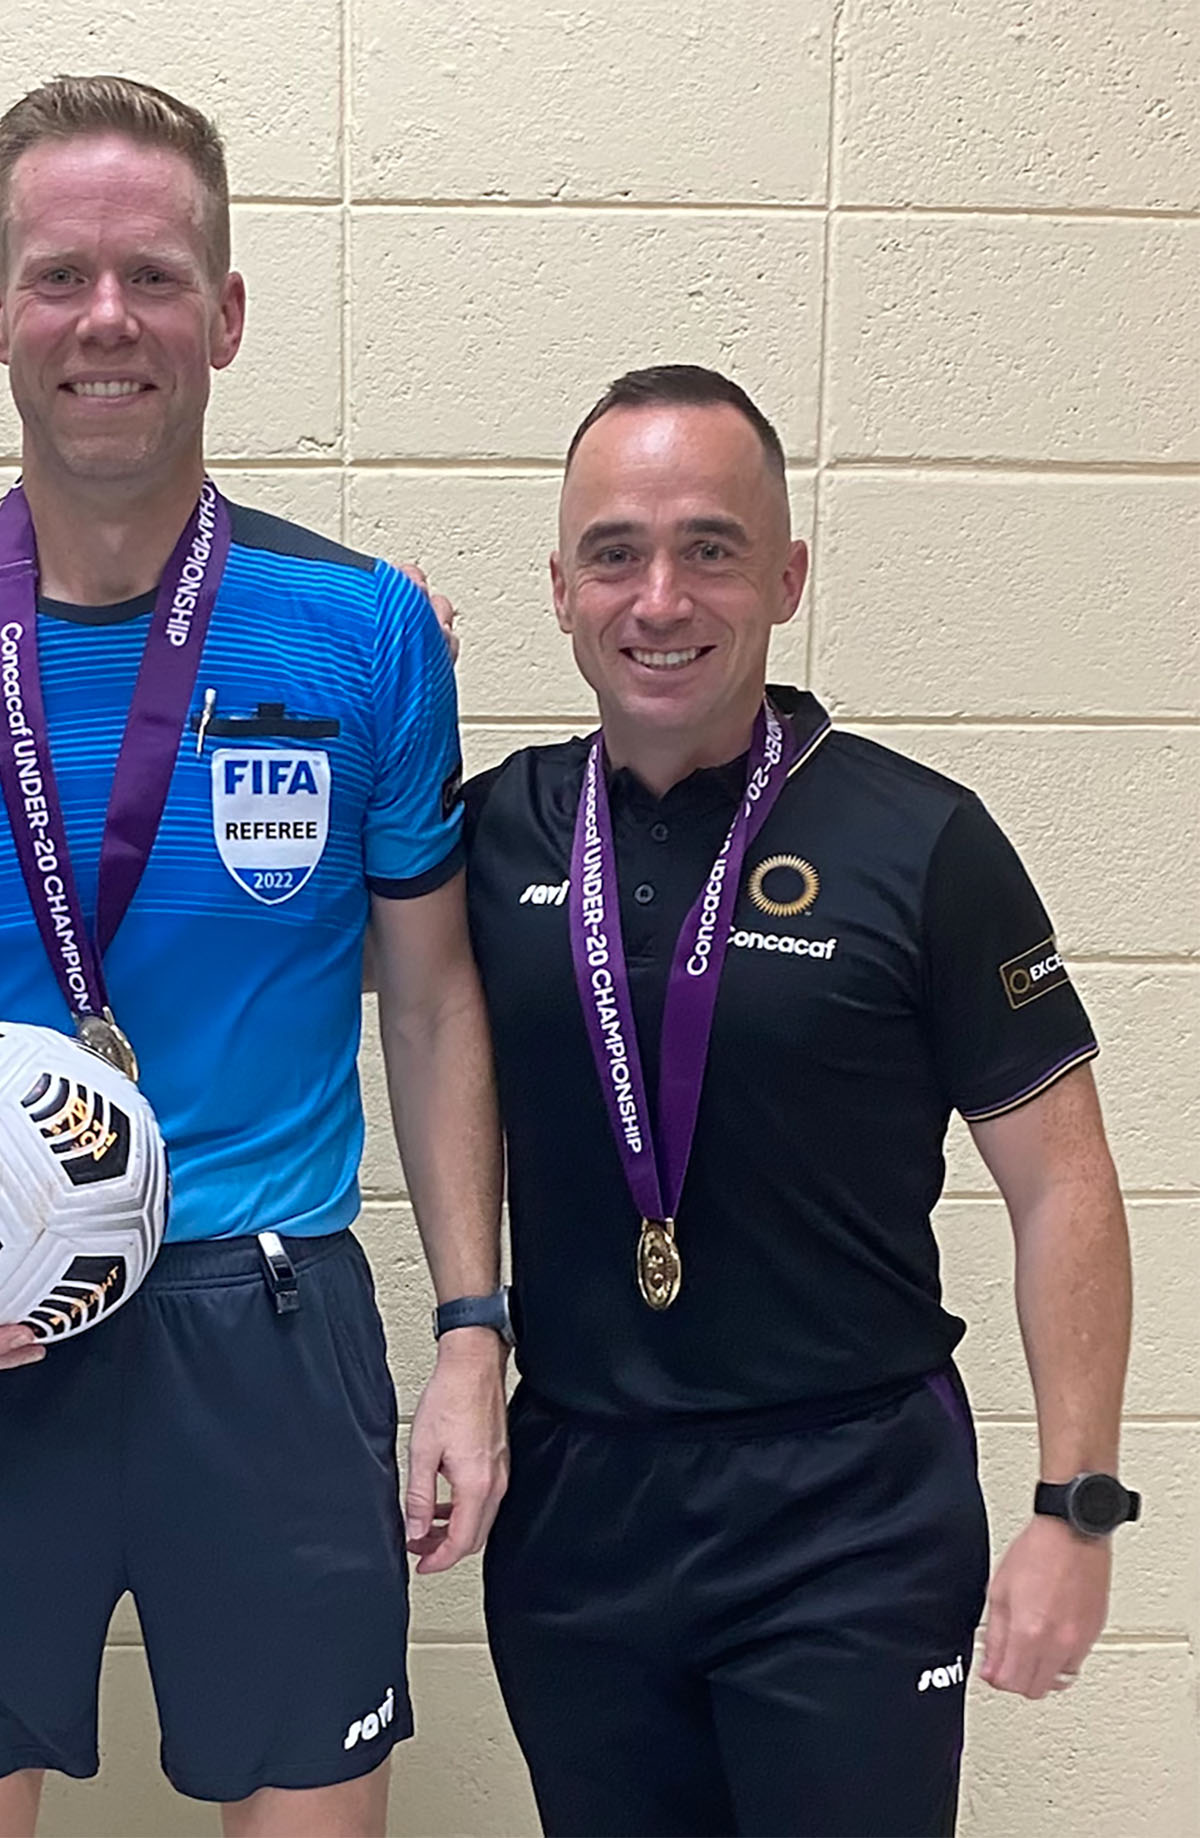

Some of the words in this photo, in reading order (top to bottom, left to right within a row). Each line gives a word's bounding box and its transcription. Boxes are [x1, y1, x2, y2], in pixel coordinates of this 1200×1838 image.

[166, 483, 217, 647] CHAMPIONSHIP
[0, 621, 26, 737] Concacaf
[13, 736, 58, 873] UNDER-20
[224, 759, 319, 795] FIFA
[585, 744, 602, 848] Concacaf
[225, 821, 318, 841] REFEREE
[253, 872, 294, 889] 2022
[582, 846, 609, 967] UNDER-20
[591, 968, 643, 1154] CHAMPIONSHIP
